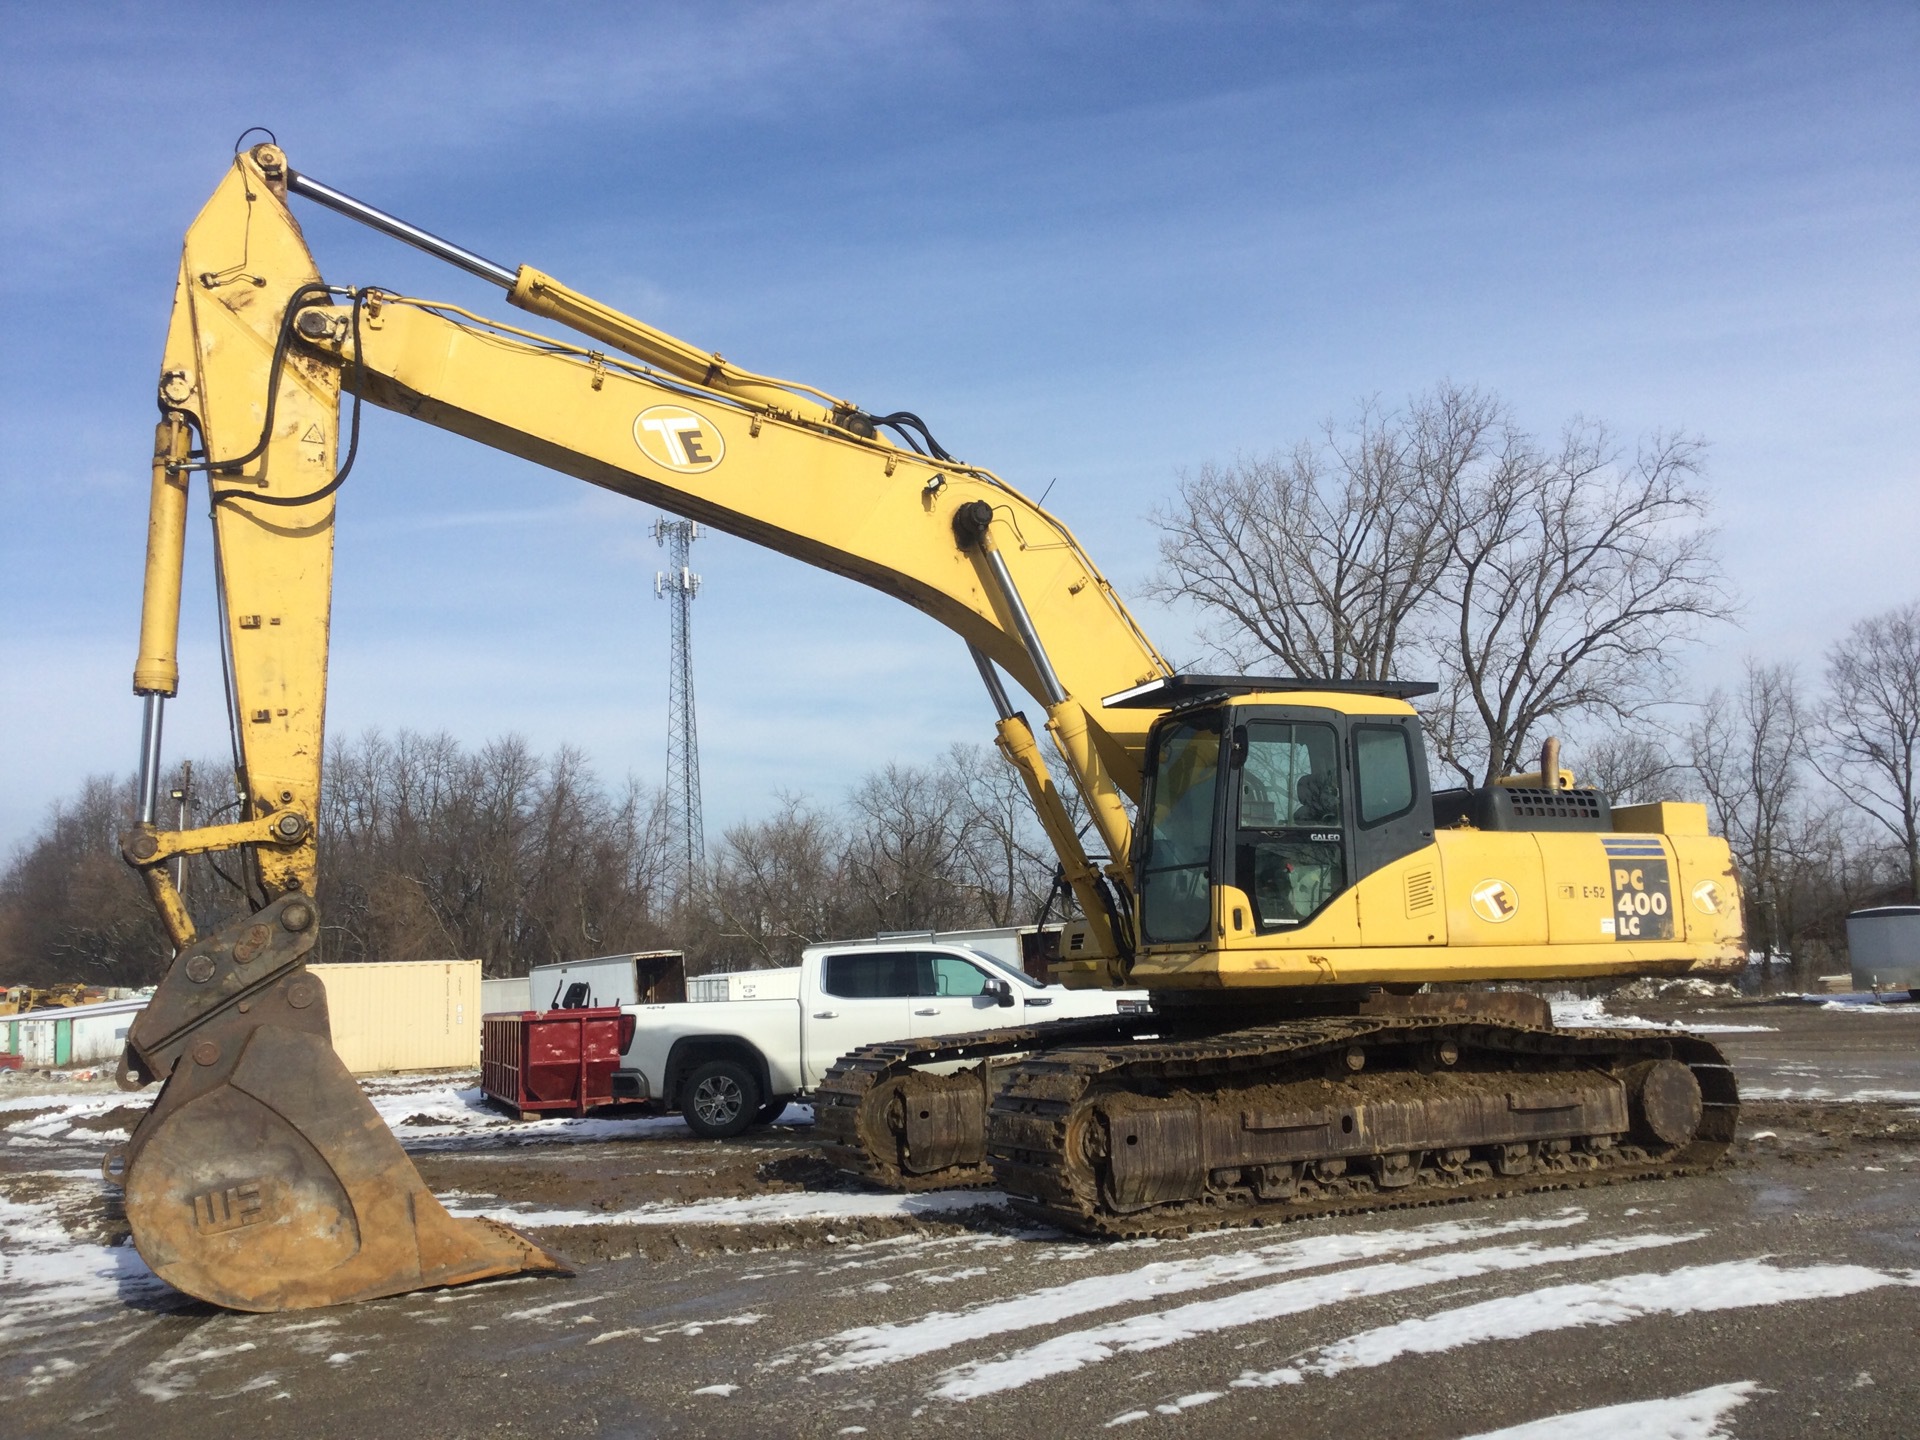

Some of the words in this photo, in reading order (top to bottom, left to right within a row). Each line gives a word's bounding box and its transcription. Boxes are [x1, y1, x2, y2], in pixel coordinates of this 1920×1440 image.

[1614, 869, 1644, 891] PC
[1583, 886, 1605, 898] E-52
[1617, 892, 1667, 916] 400
[1619, 917, 1640, 936] LC
